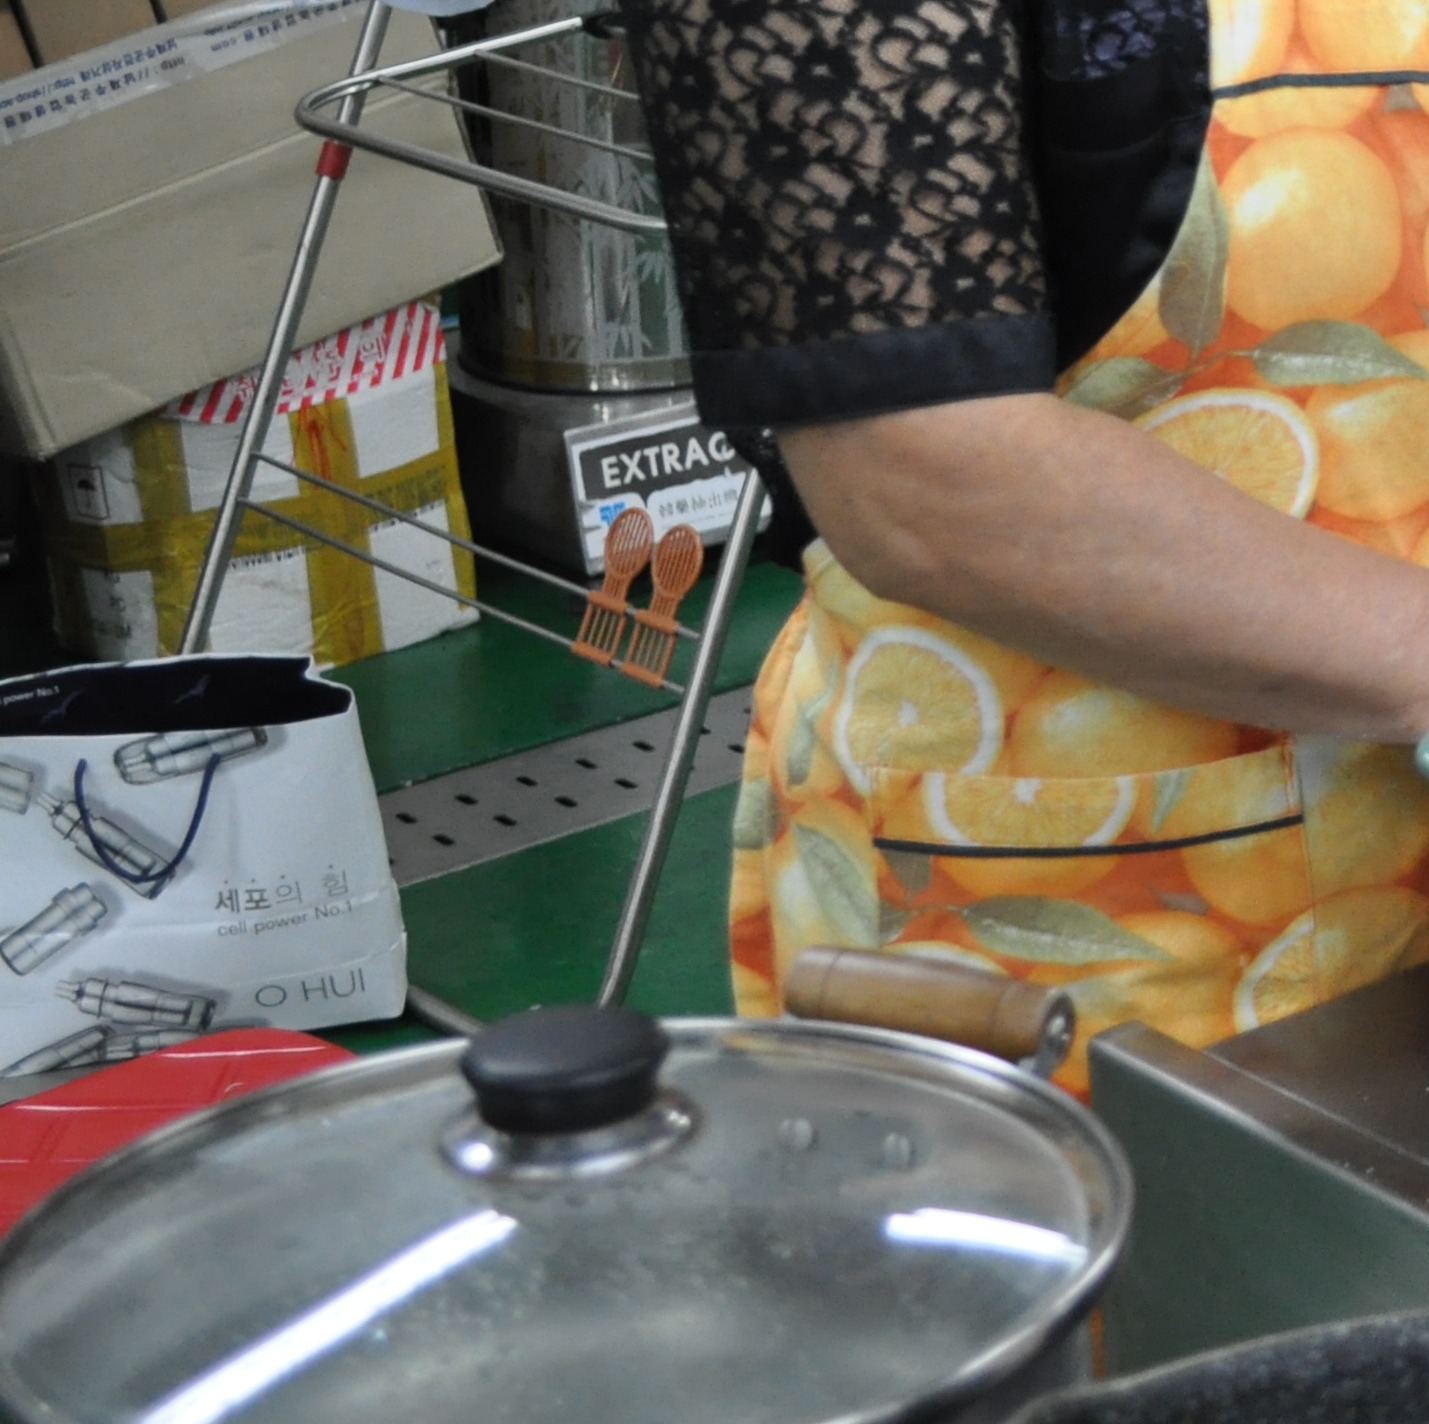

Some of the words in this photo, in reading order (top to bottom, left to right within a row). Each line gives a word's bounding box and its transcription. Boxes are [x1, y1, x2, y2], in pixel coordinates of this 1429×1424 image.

[214, 880, 303, 914] 세포의
[321, 869, 350, 898] 힘
[217, 920, 248, 937] cell
[253, 912, 309, 936] power
[314, 900, 353, 920] No.1
[255, 984, 288, 1007] O
[301, 967, 366, 1002] HUI
